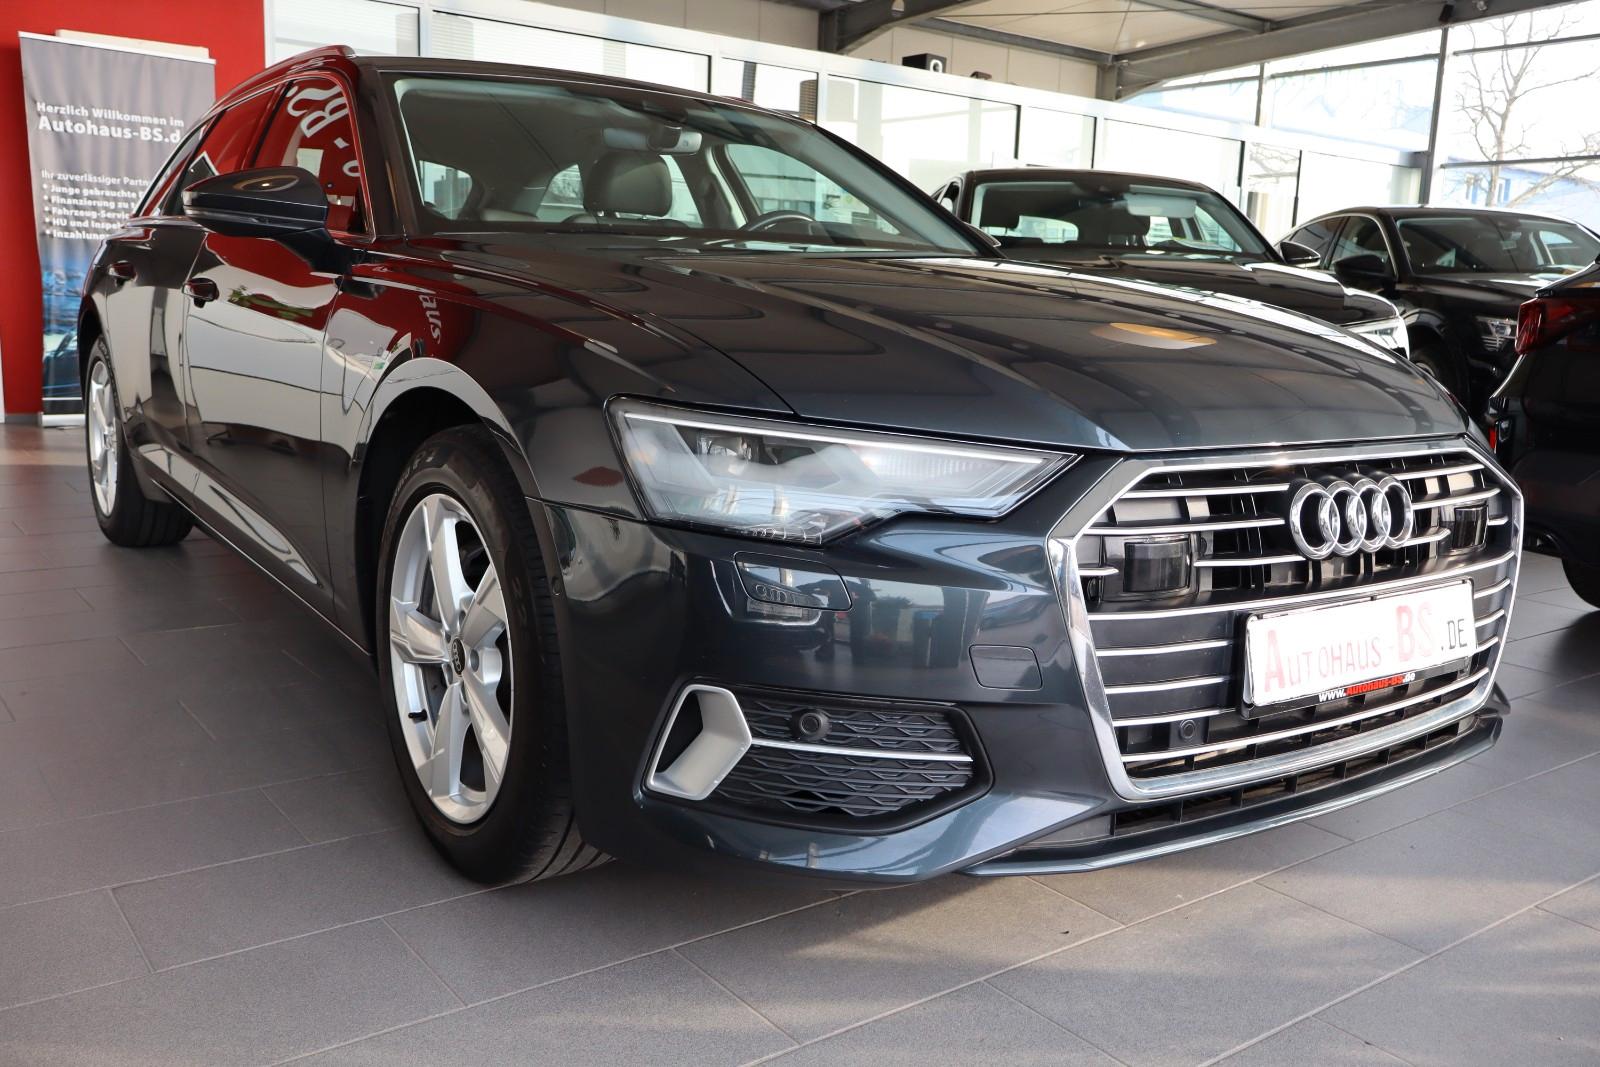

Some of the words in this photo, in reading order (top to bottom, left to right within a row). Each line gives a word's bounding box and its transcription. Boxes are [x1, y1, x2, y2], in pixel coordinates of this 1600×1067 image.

[36, 101, 89, 117] Herzlich
[92, 107, 167, 126] Willkommen
[169, 116, 185, 128] im
[41, 169, 54, 180] Ihr
[56, 172, 121, 186] zuverlässiger
[51, 184, 80, 196] Junge
[82, 186, 137, 199] gebrauchte
[51, 195, 115, 209] Finanzierung
[117, 201, 129, 209] zu
[53, 218, 67, 227] HU
[69, 219, 89, 228] und
[53, 229, 110, 240] Inzahlung
